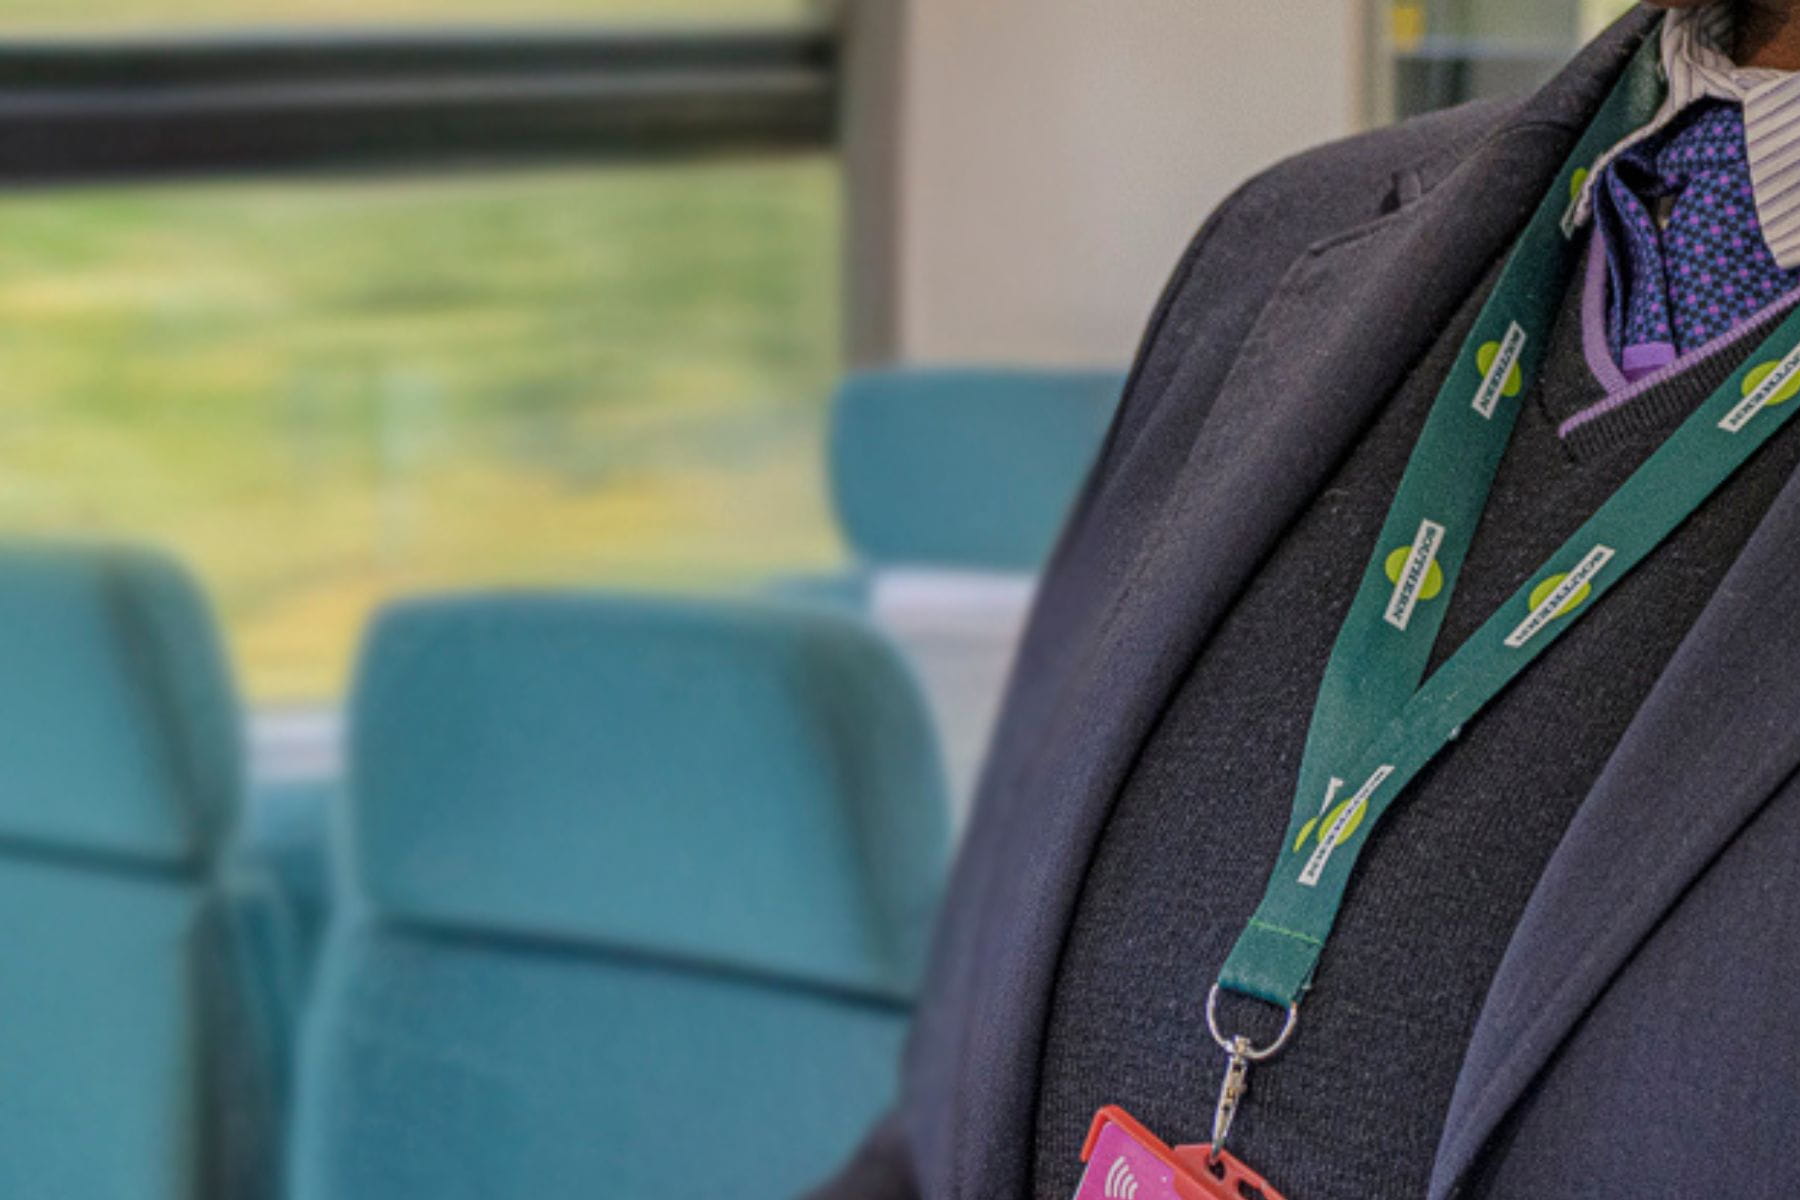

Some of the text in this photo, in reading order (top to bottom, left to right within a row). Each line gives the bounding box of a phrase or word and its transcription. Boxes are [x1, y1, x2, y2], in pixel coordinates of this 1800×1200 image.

[1481, 329, 1523, 411] SOUTHERN
[1391, 526, 1439, 621] SOUTHERN
[1514, 549, 1606, 643] SOUTHERN
